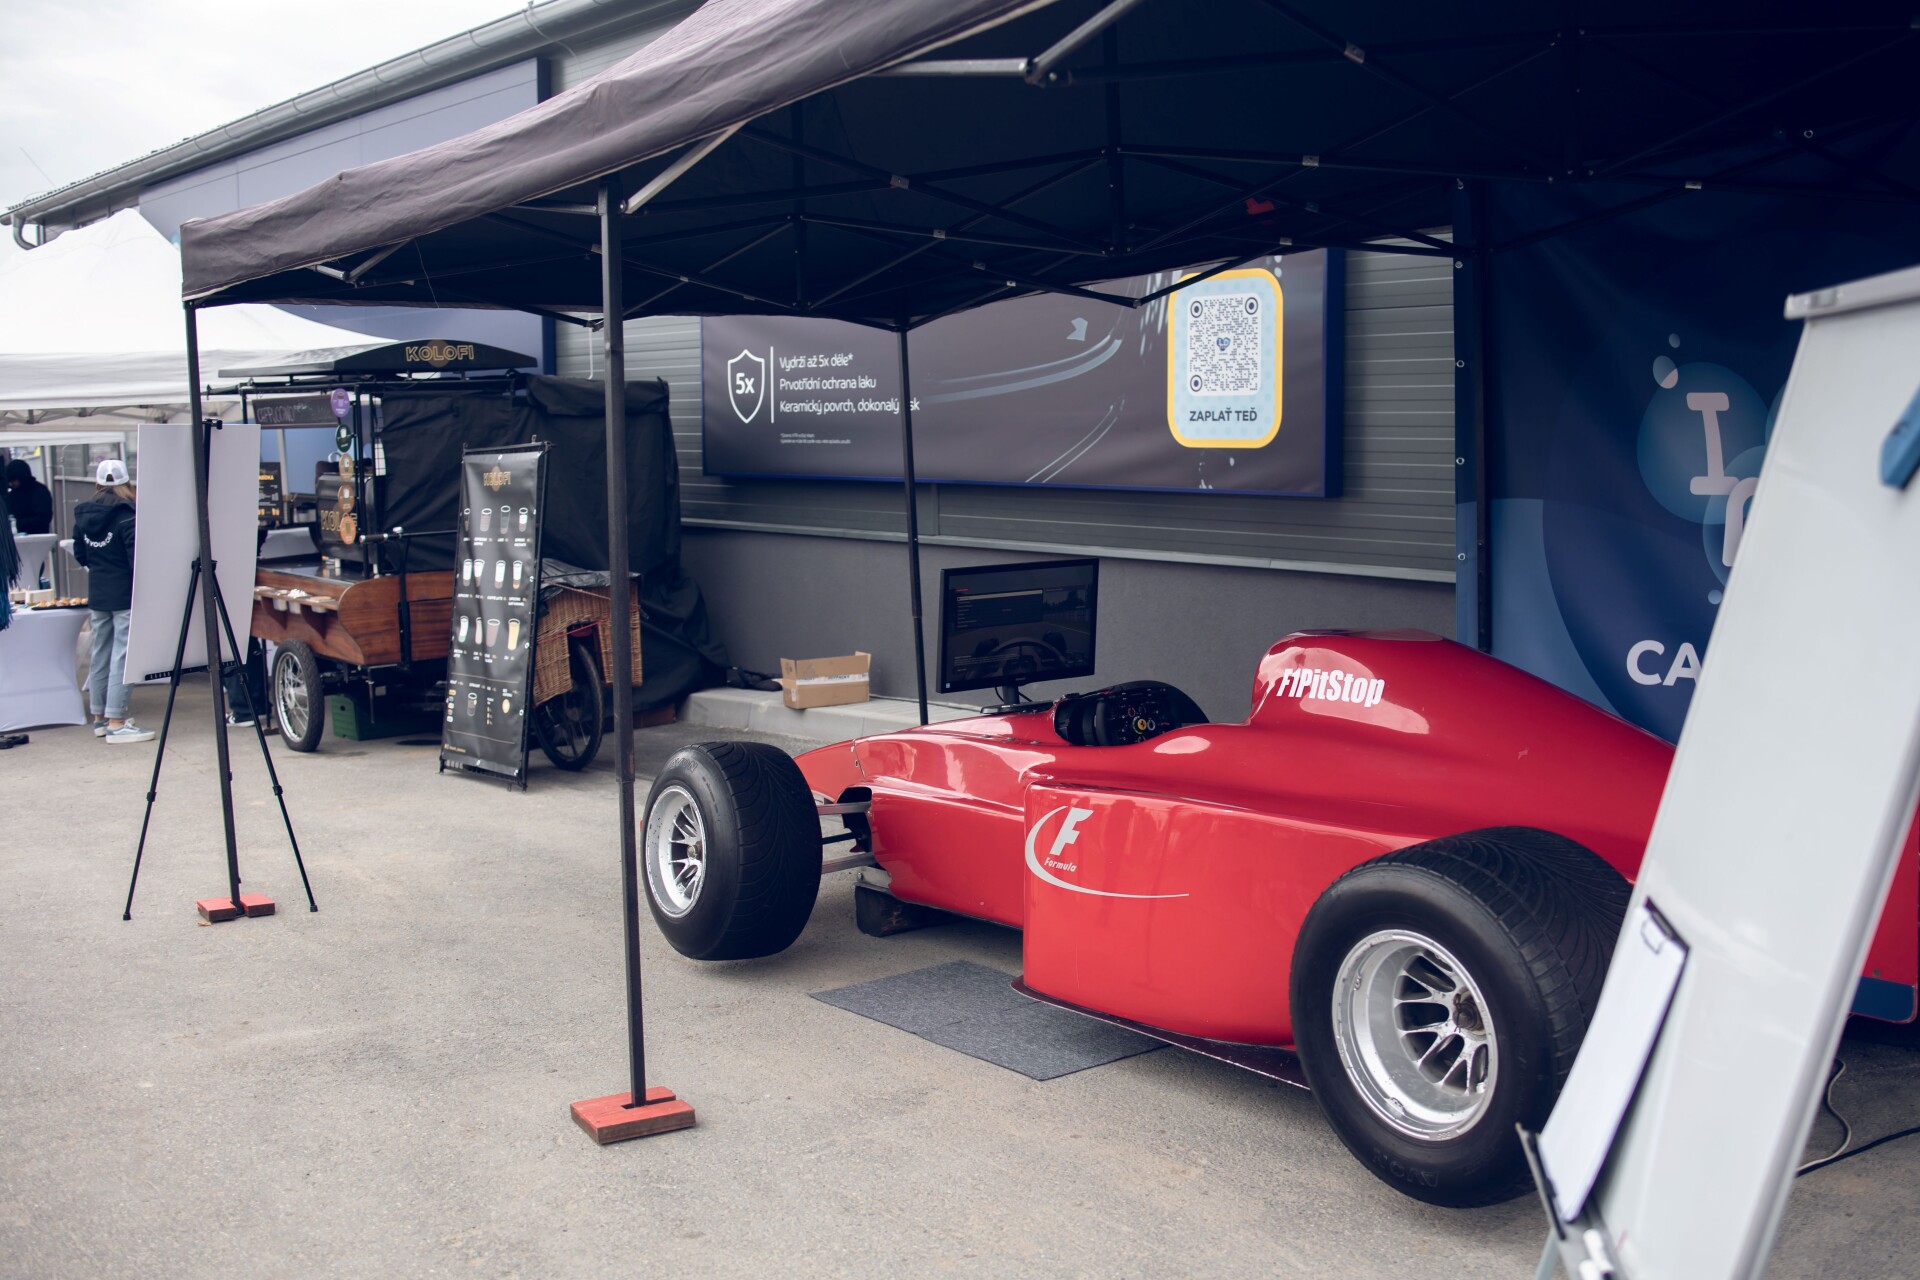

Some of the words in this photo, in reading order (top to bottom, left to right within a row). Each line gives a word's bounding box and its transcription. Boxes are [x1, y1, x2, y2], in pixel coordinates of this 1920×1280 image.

[405, 345, 474, 362] KOLOFI
[779, 355, 805, 371] Vydrží
[806, 354, 817, 368] až
[818, 354, 829, 368] 5x
[736, 373, 755, 394] 5x
[779, 377, 820, 391] Prvotřídní
[821, 375, 857, 389] ochrana
[858, 375, 876, 389] laku
[780, 400, 822, 415] Keramický
[823, 399, 856, 415] povrch,
[857, 398, 899, 414] dokonalý
[1189, 407, 1232, 422] ZAPLAŤ
[1235, 407, 1257, 422] TEĎ
[1626, 640, 1702, 686] CA
[1276, 668, 1385, 707] F1PitStop
[1049, 807, 1094, 856] F
[1044, 857, 1077, 872] Formula
